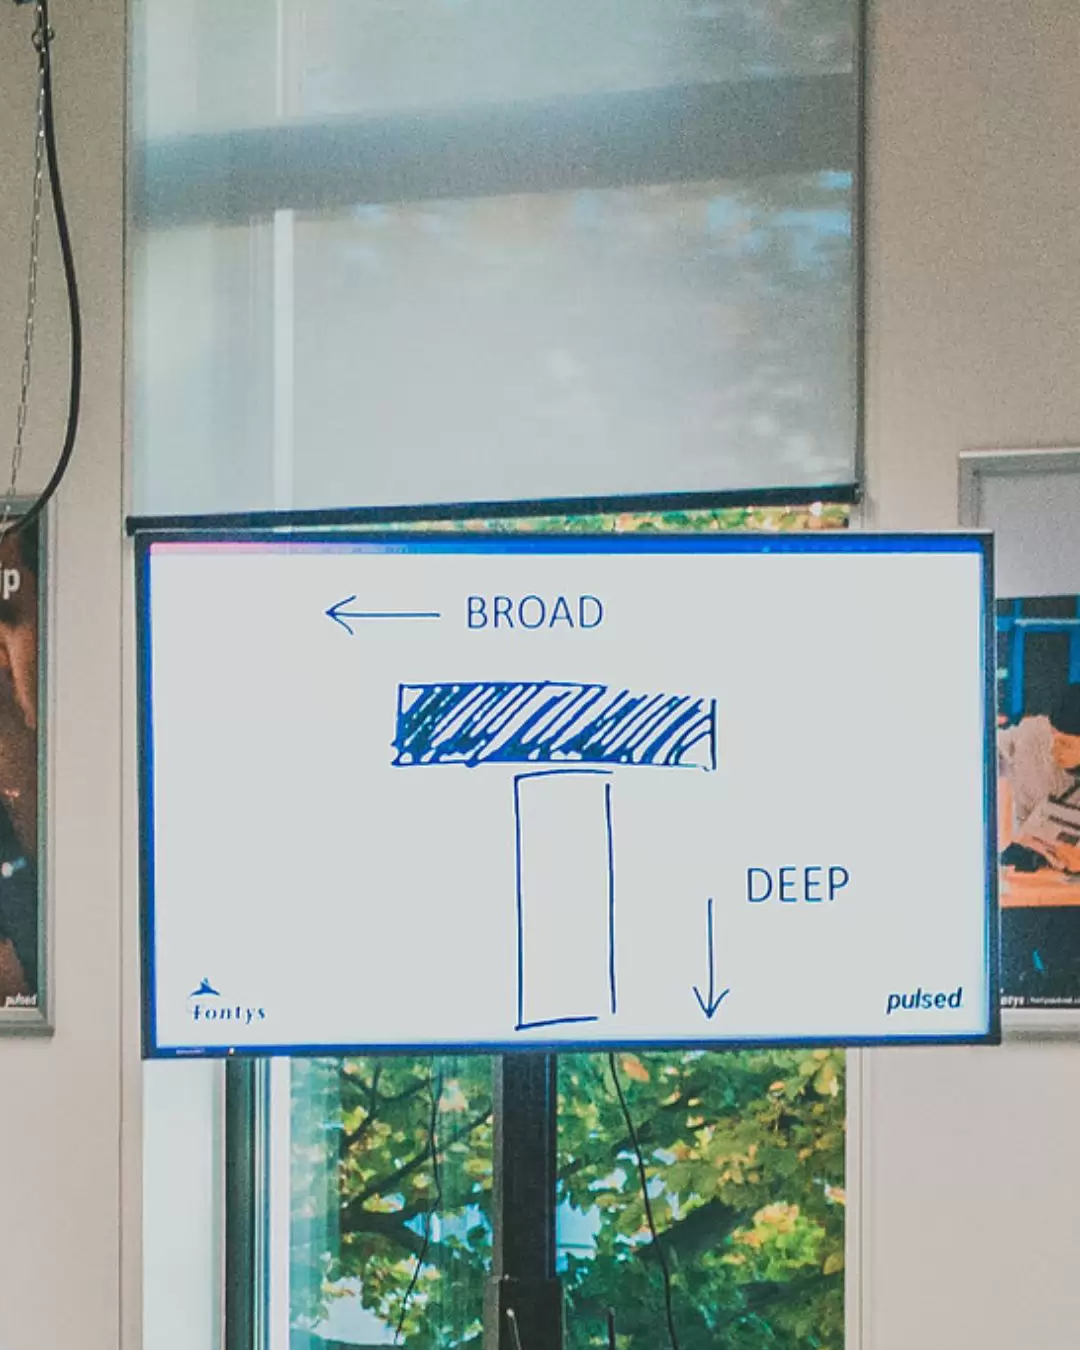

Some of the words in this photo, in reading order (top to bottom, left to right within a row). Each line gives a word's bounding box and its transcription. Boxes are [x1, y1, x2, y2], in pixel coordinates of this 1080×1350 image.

[467, 594, 604, 629] BROAD
[747, 866, 850, 903] DEEP
[886, 986, 962, 1014] pulsed
